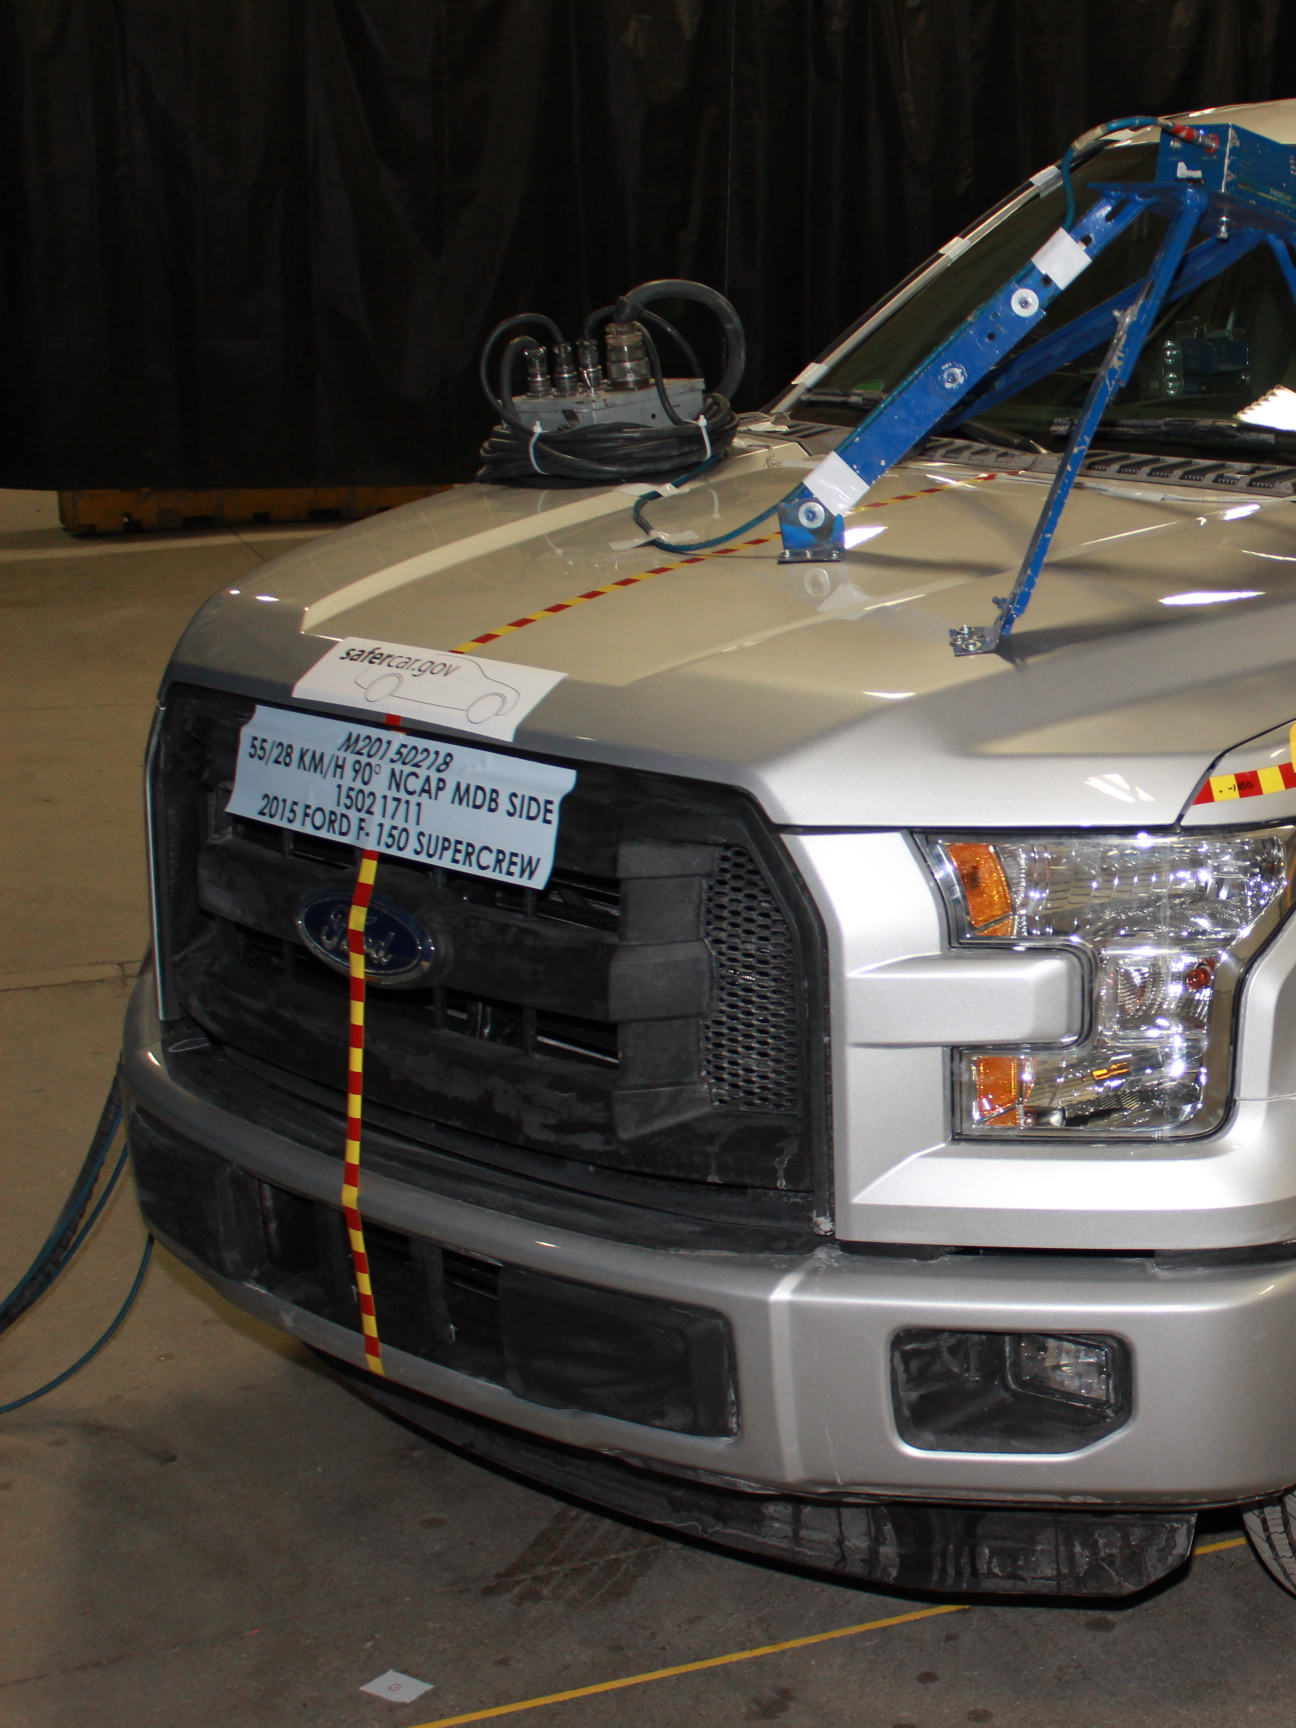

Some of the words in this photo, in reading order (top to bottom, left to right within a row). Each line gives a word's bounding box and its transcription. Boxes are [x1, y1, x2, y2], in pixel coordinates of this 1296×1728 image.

[339, 646, 461, 678] safercar.gov
[337, 732, 453, 774] M20150218
[248, 736, 294, 767] 55/28
[298, 747, 346, 781] KM/H
[352, 763, 381, 786] 90°
[389, 773, 447, 802] NCAP
[451, 784, 500, 812] MDB
[506, 796, 555, 826] SIDE
[335, 784, 423, 826] 15021711
[258, 793, 298, 823] 2015
[302, 804, 351, 836] FORD
[413, 832, 541, 881] SUPERCREW
